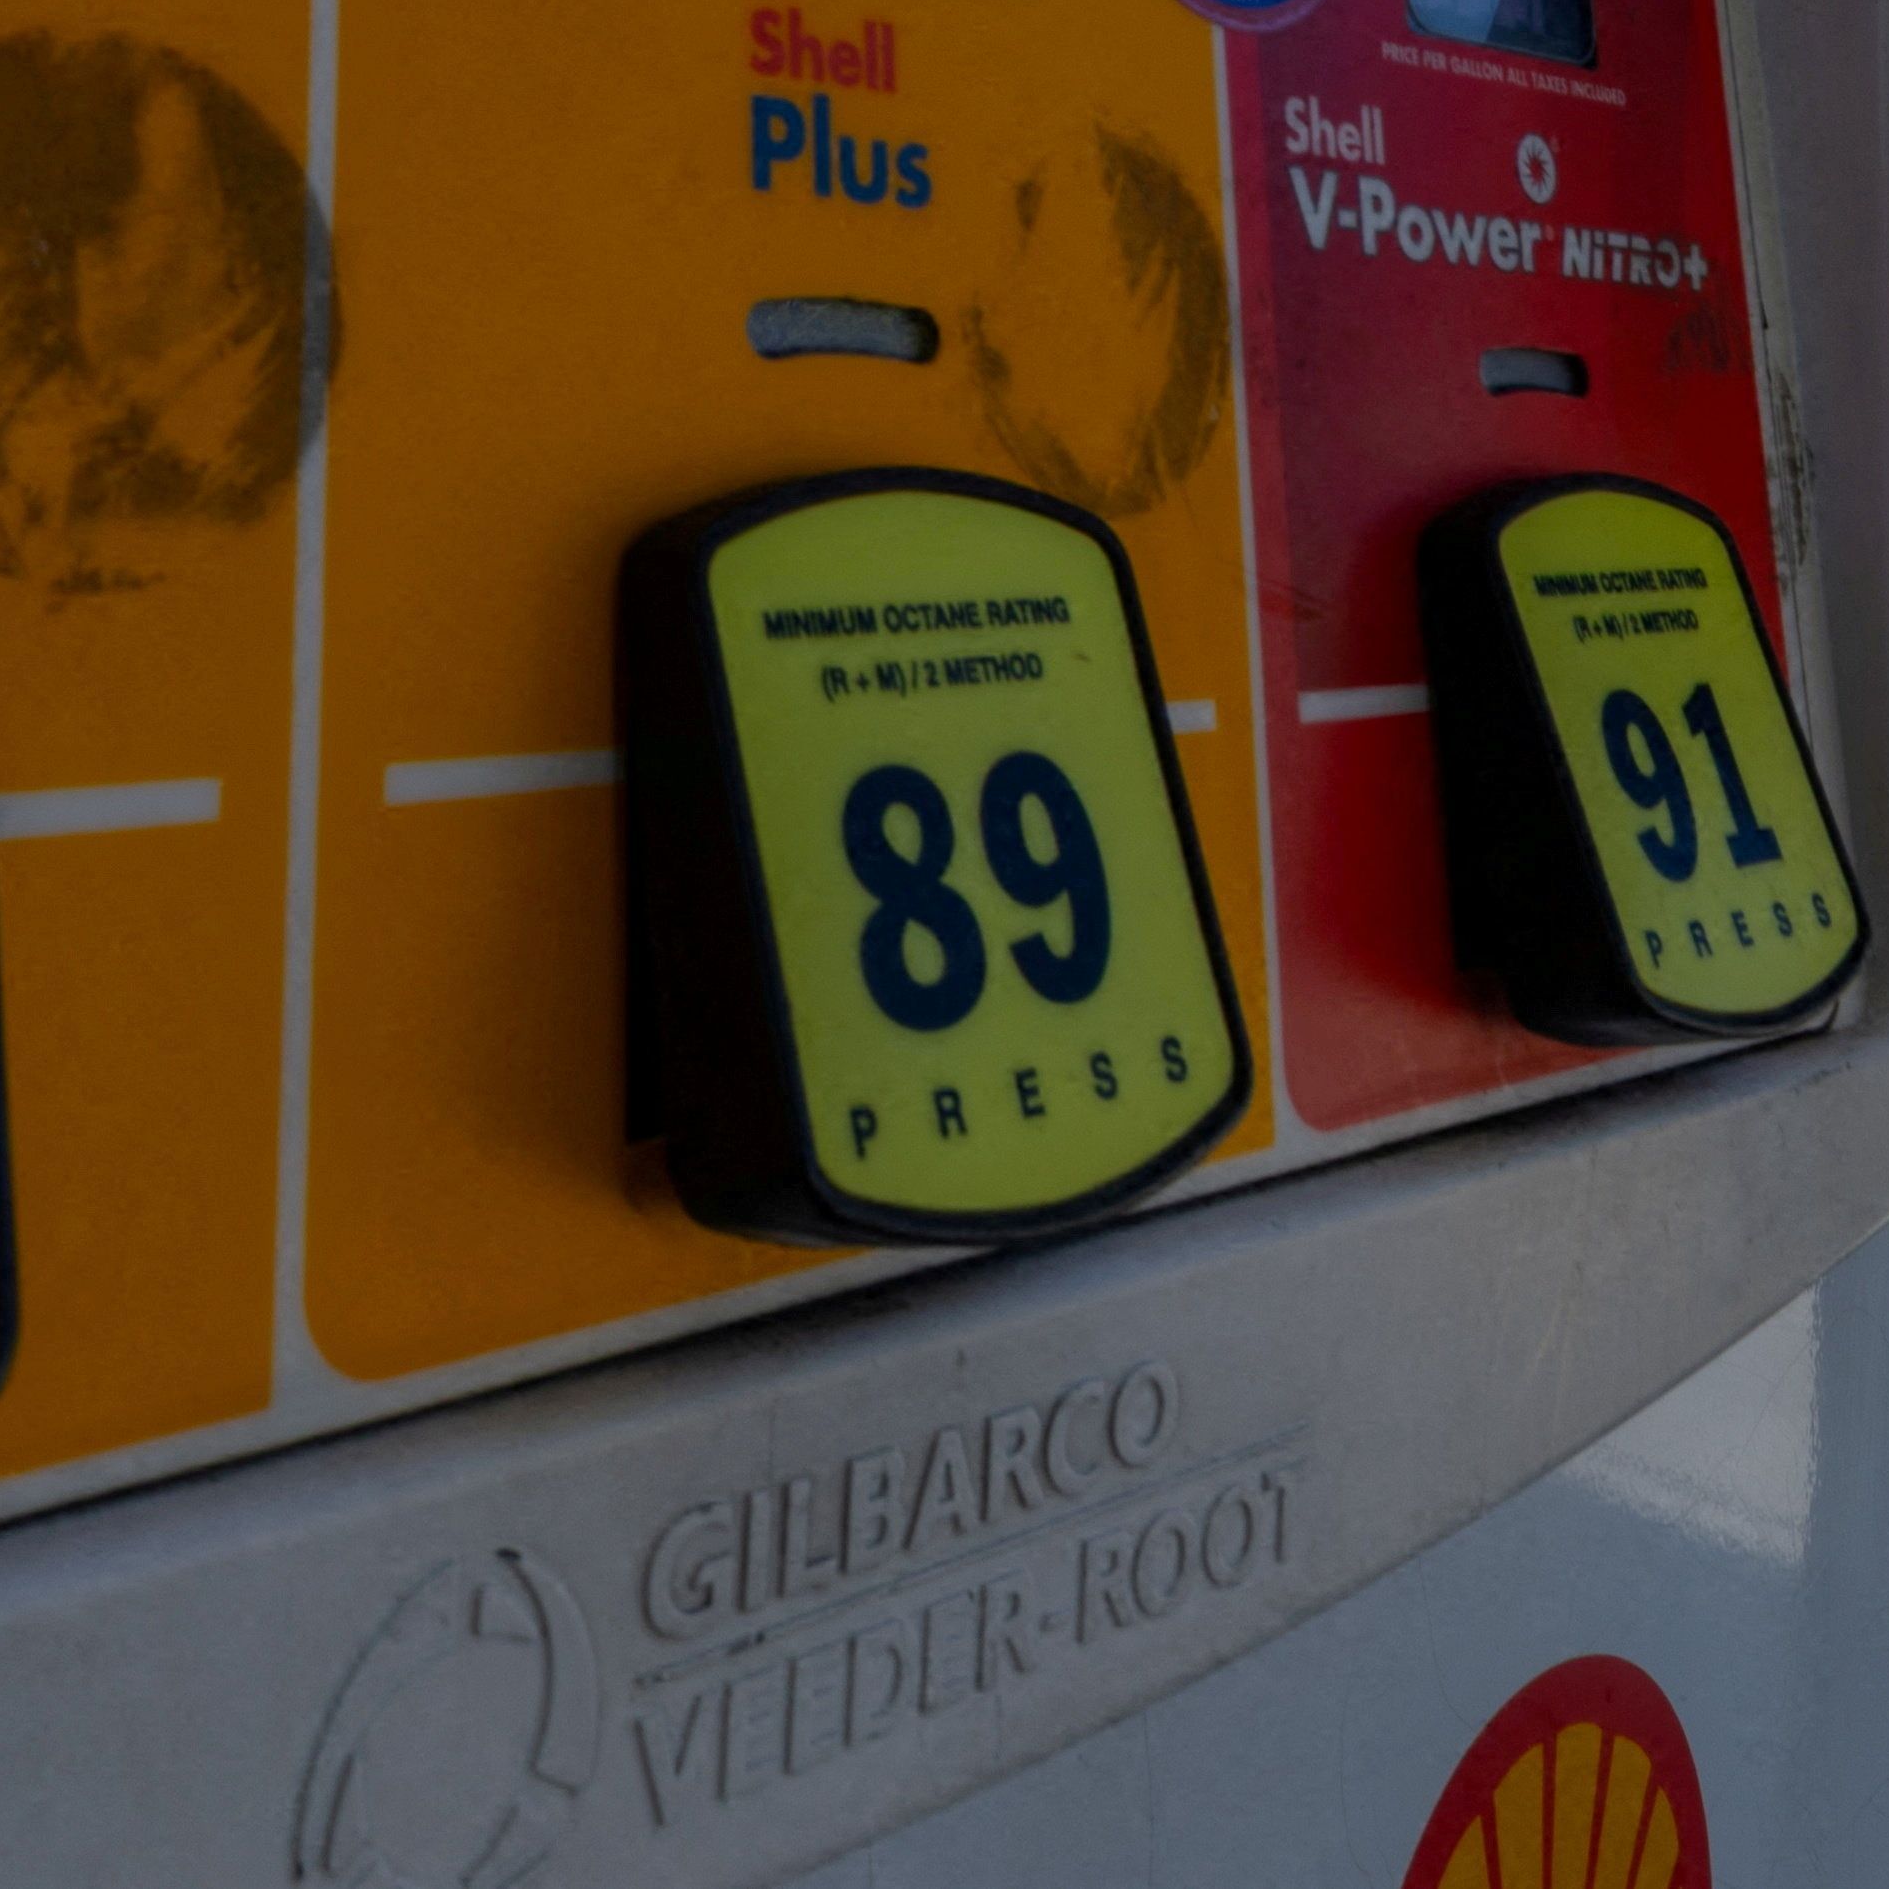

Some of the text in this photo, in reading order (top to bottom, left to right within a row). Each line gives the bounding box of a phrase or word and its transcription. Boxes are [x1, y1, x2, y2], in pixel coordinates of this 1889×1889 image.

[749, 6, 897, 95] Shell
[1381, 40, 1627, 109] PRICE PER GALLON ALL TAXES INCLUDED
[750, 91, 933, 211] Plus
[1283, 94, 1386, 166] Shell
[1288, 164, 1543, 273] V-Power
[764, 596, 1070, 641] MINIMUM OCTANE RATING
[1598, 569, 1660, 594] OCTANE
[1655, 566, 1709, 590] RATING
[1639, 608, 1700, 635] METHOD
[944, 652, 1044, 685] METHOD
[1601, 681, 1784, 883] 91
[842, 750, 1113, 1033] 89
[638, 1357, 1182, 1644] GILBARCO
[631, 1467, 1297, 1830] VEEDER-ROOT
